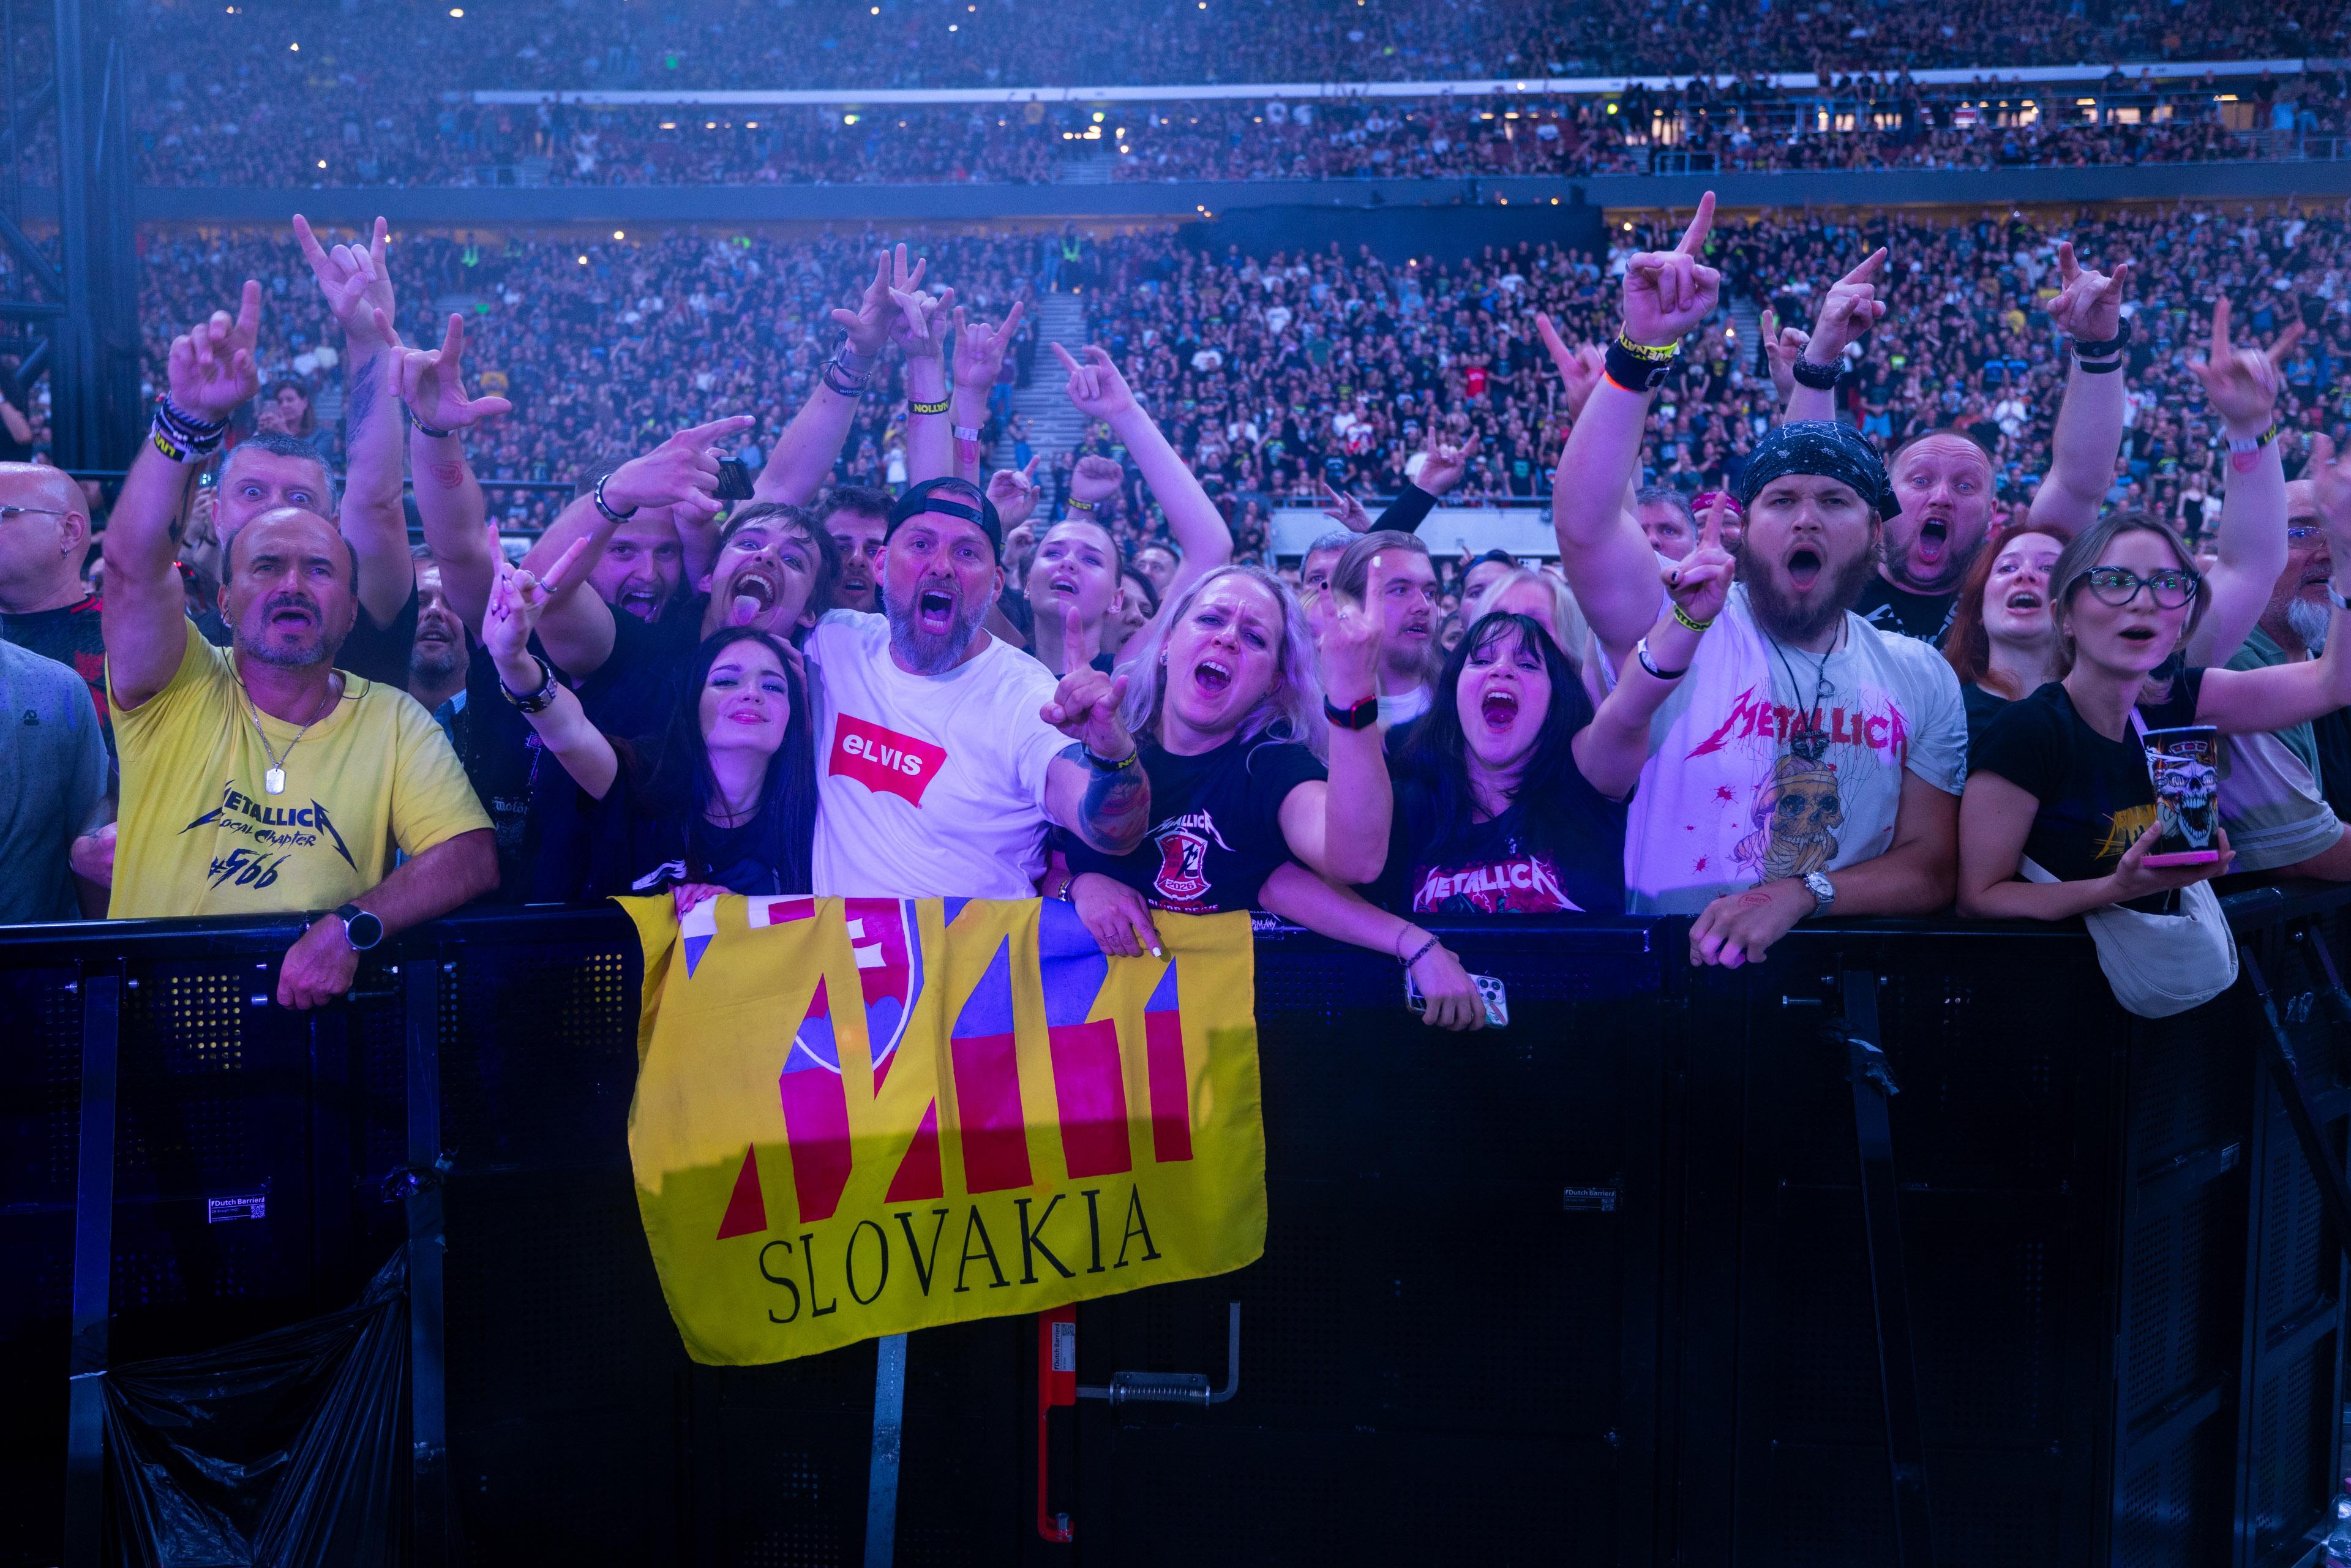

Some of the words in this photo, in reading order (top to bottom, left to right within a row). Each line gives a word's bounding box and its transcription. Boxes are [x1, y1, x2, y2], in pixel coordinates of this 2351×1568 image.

[914, 402, 948, 413] NATION
[1685, 683, 1911, 770] METALLICA
[1143, 809, 1236, 852] MALLICA
[207, 848, 291, 891] #566
[1167, 880, 1194, 890] 2026
[1412, 855, 1587, 912] METALLICA
[1252, 918, 1276, 931] RMANY
[759, 1184, 1161, 1324] SLOVAKIA
